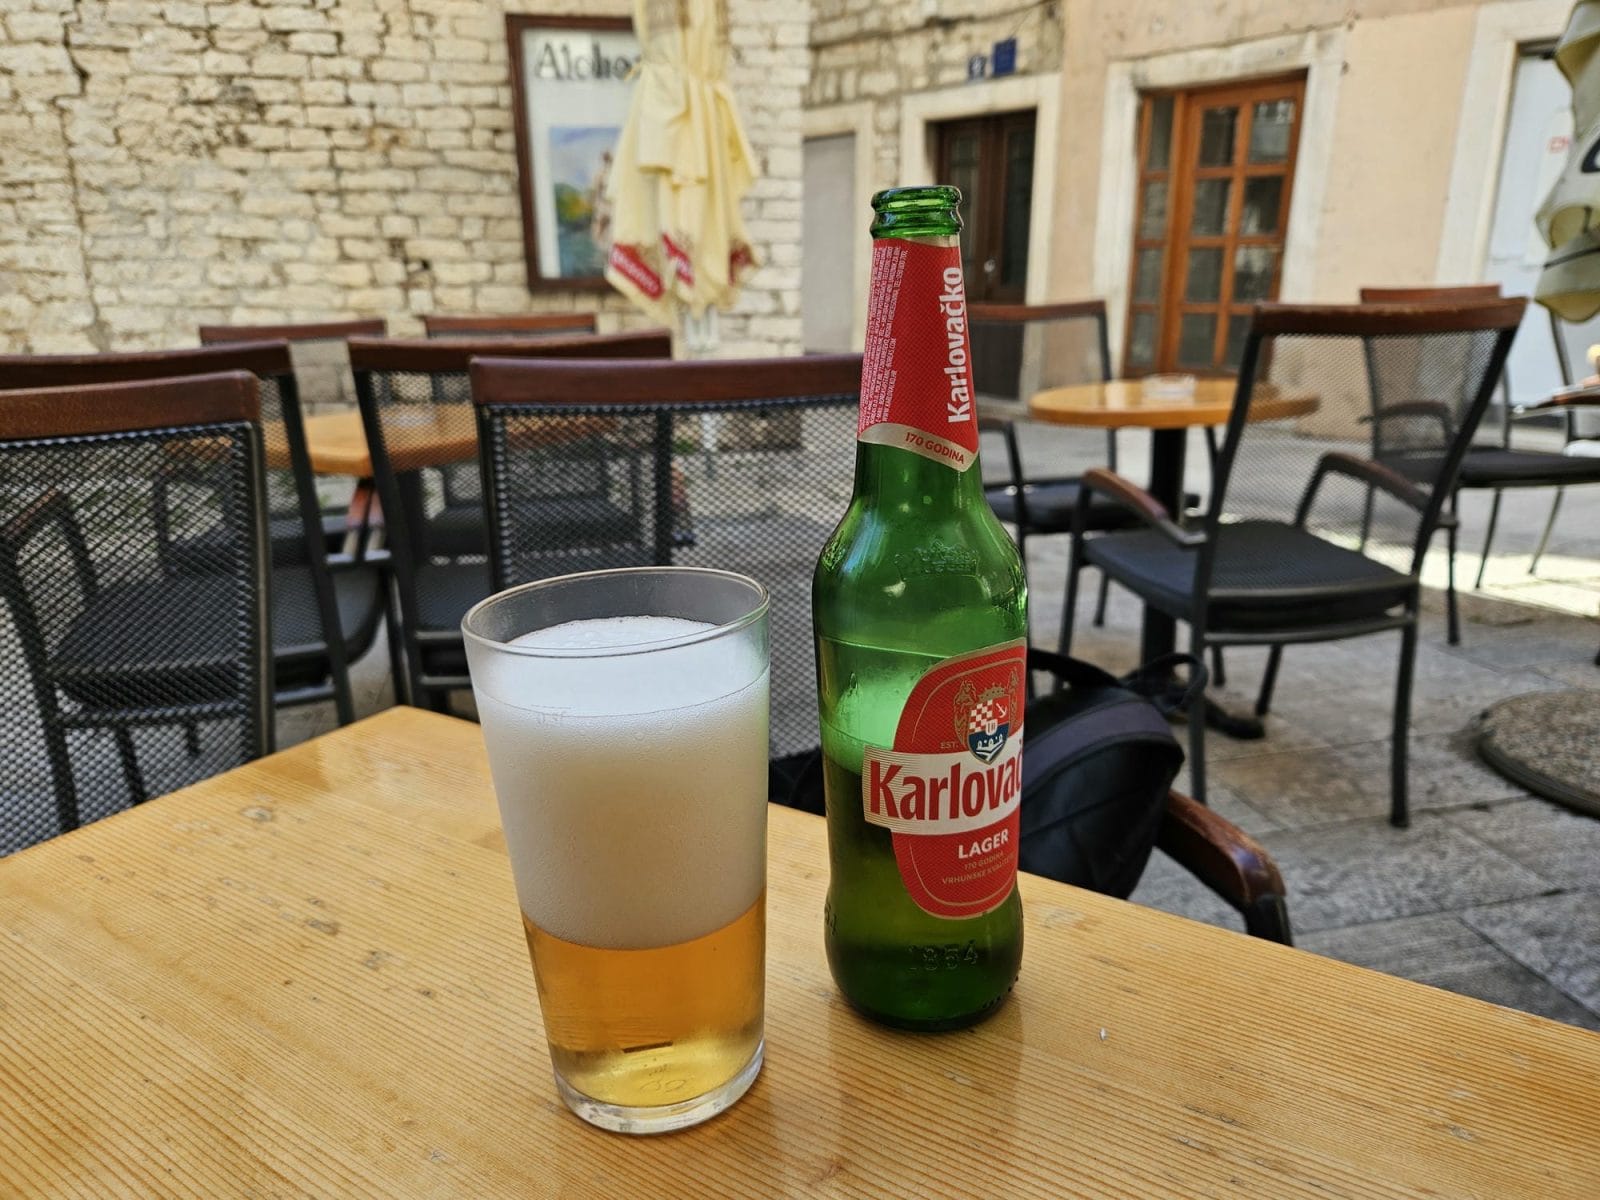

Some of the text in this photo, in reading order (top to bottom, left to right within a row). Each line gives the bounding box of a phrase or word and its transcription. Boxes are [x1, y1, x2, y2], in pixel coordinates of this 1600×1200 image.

[534, 43, 641, 80] Alcho
[939, 267, 971, 422] Karlovačko
[905, 431, 964, 464] 170 GODINA
[940, 741, 959, 749] EST.
[958, 828, 1008, 859] LAGER
[942, 869, 986, 885] VRHUNSKE
